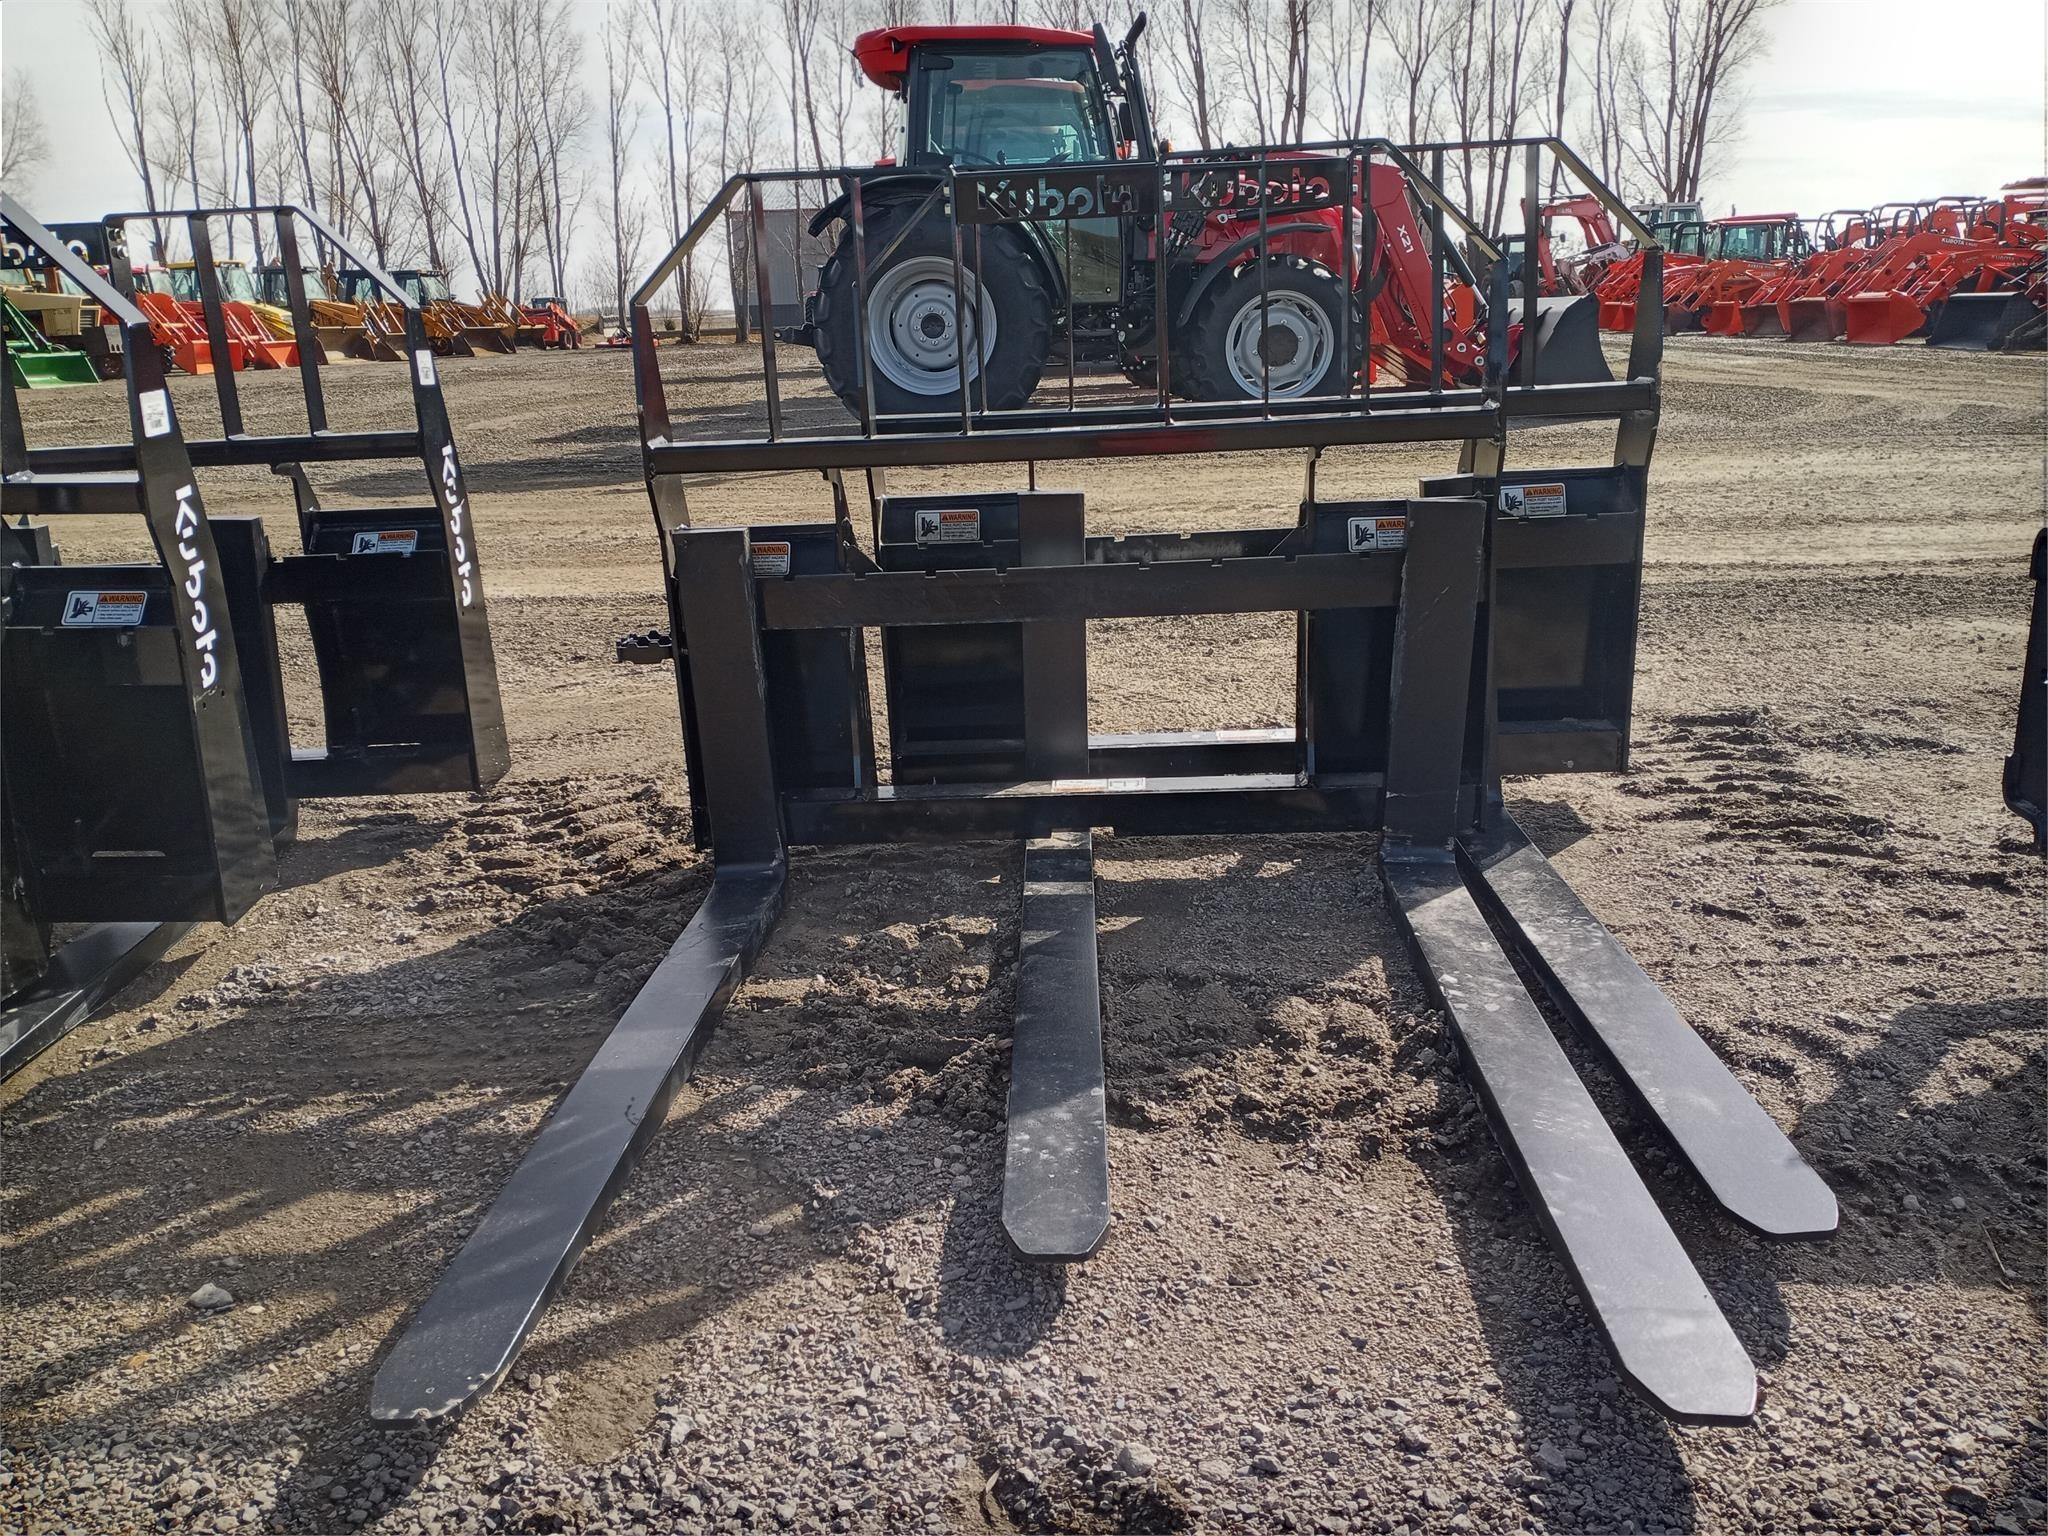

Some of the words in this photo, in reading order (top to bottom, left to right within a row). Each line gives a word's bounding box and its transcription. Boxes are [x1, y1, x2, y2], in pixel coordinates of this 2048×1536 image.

[977, 175, 1139, 218] Kubota
[1182, 167, 1330, 207] Kubota
[1397, 224, 1414, 253] X21
[1941, 237, 1965, 246] KUBOTA
[1532, 487, 1562, 496] WARNING
[442, 444, 472, 607] Kubota
[949, 513, 976, 521] WARNING
[757, 545, 787, 553] WARNING
[175, 484, 217, 689] Kubota
